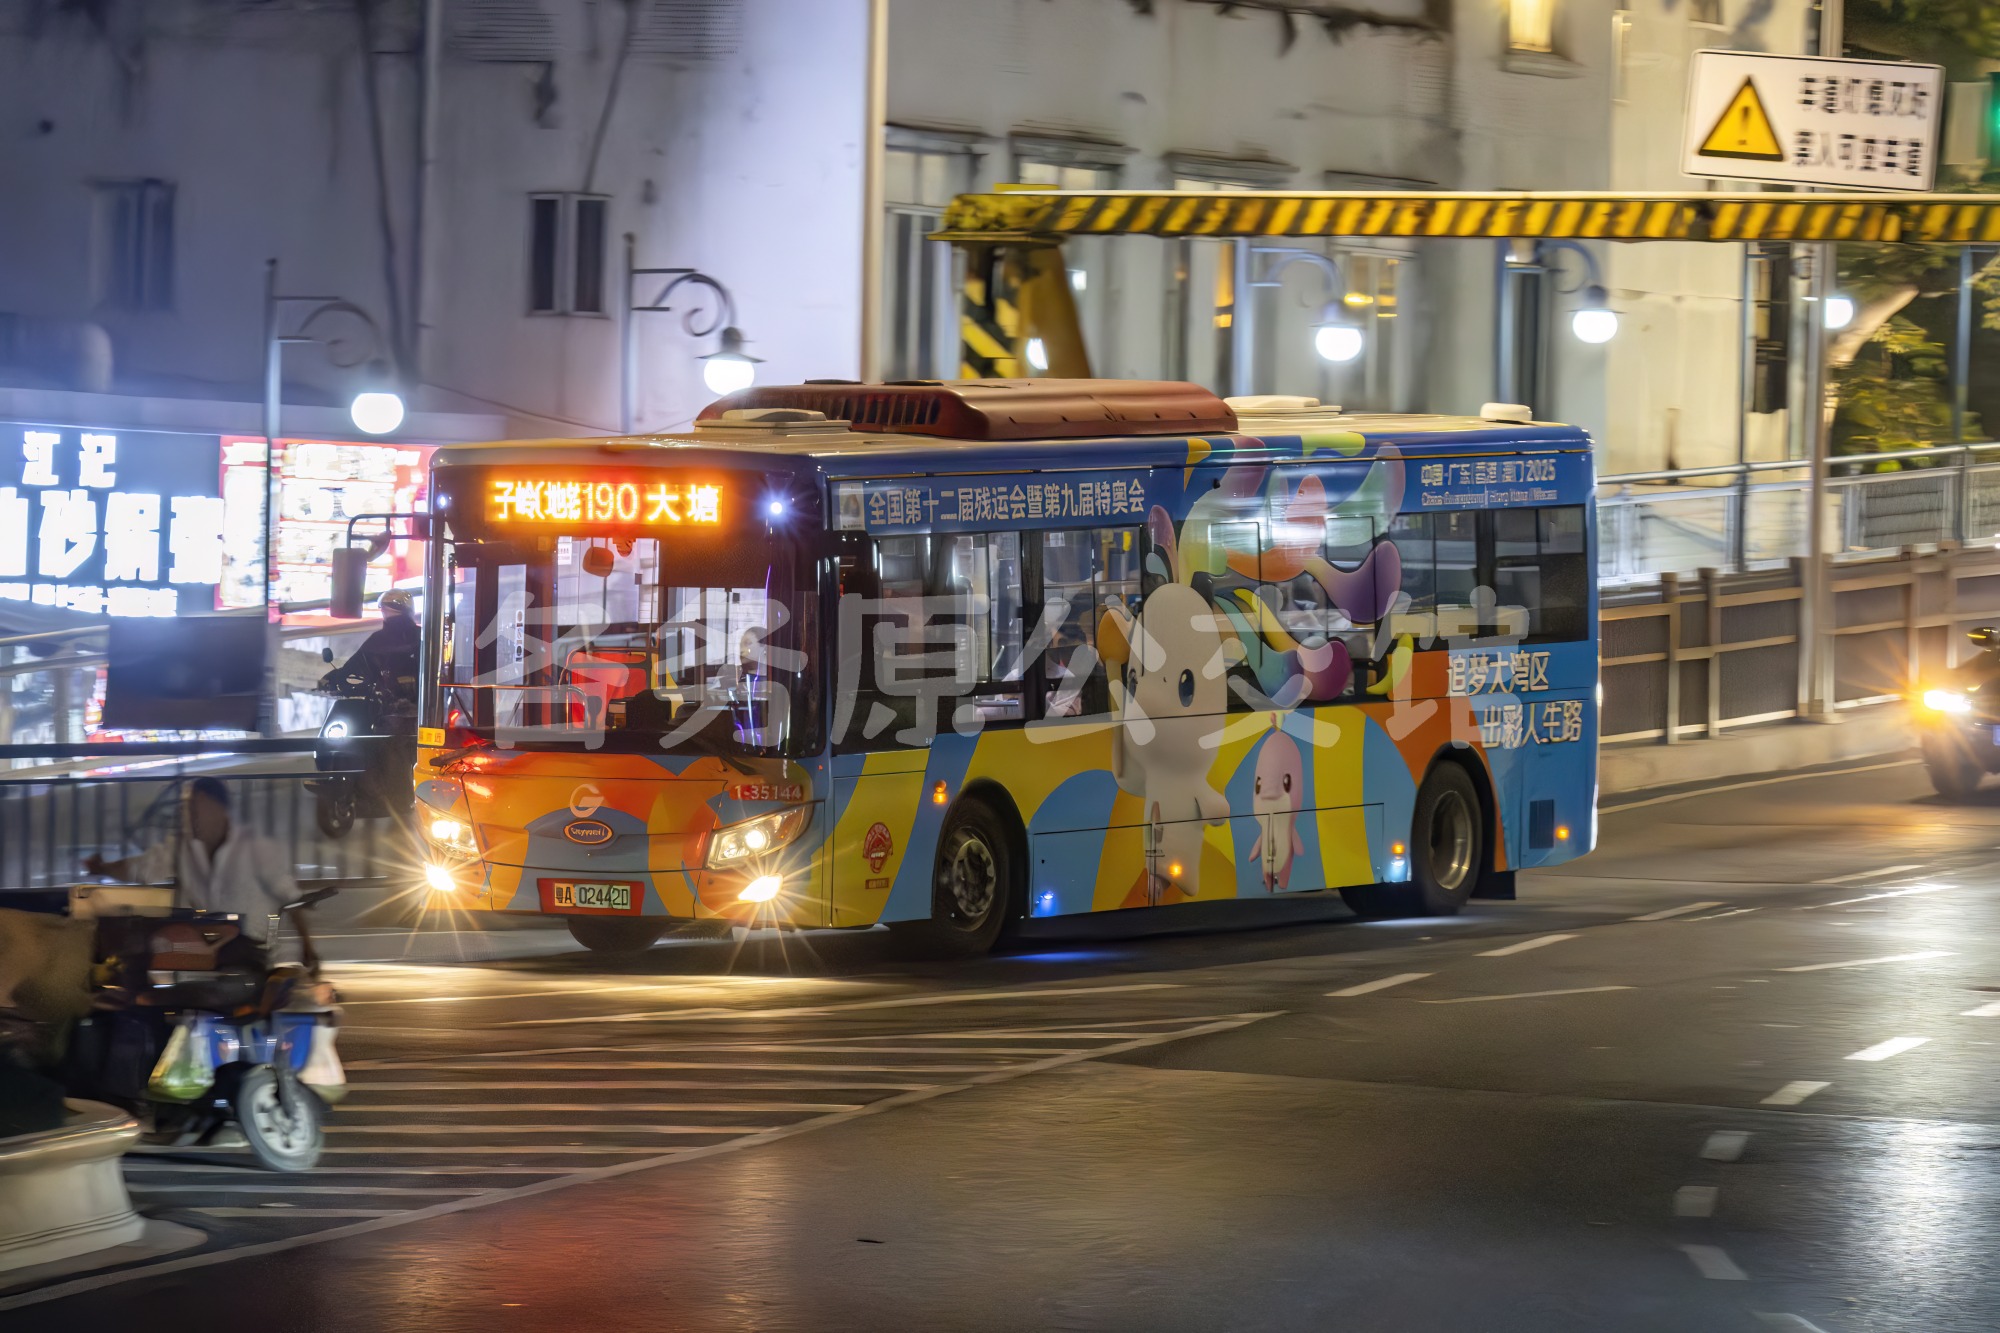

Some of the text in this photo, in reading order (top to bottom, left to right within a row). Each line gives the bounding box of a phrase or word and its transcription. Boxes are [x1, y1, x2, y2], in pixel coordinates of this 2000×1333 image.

[586, 482, 638, 521] 190
[647, 484, 719, 523] 大塘
[869, 478, 1145, 526] 全国第十二届残运会暨第九届特奥会
[1446, 650, 1551, 697] 追梦大湾区
[1481, 700, 1583, 749] 出彩人生路
